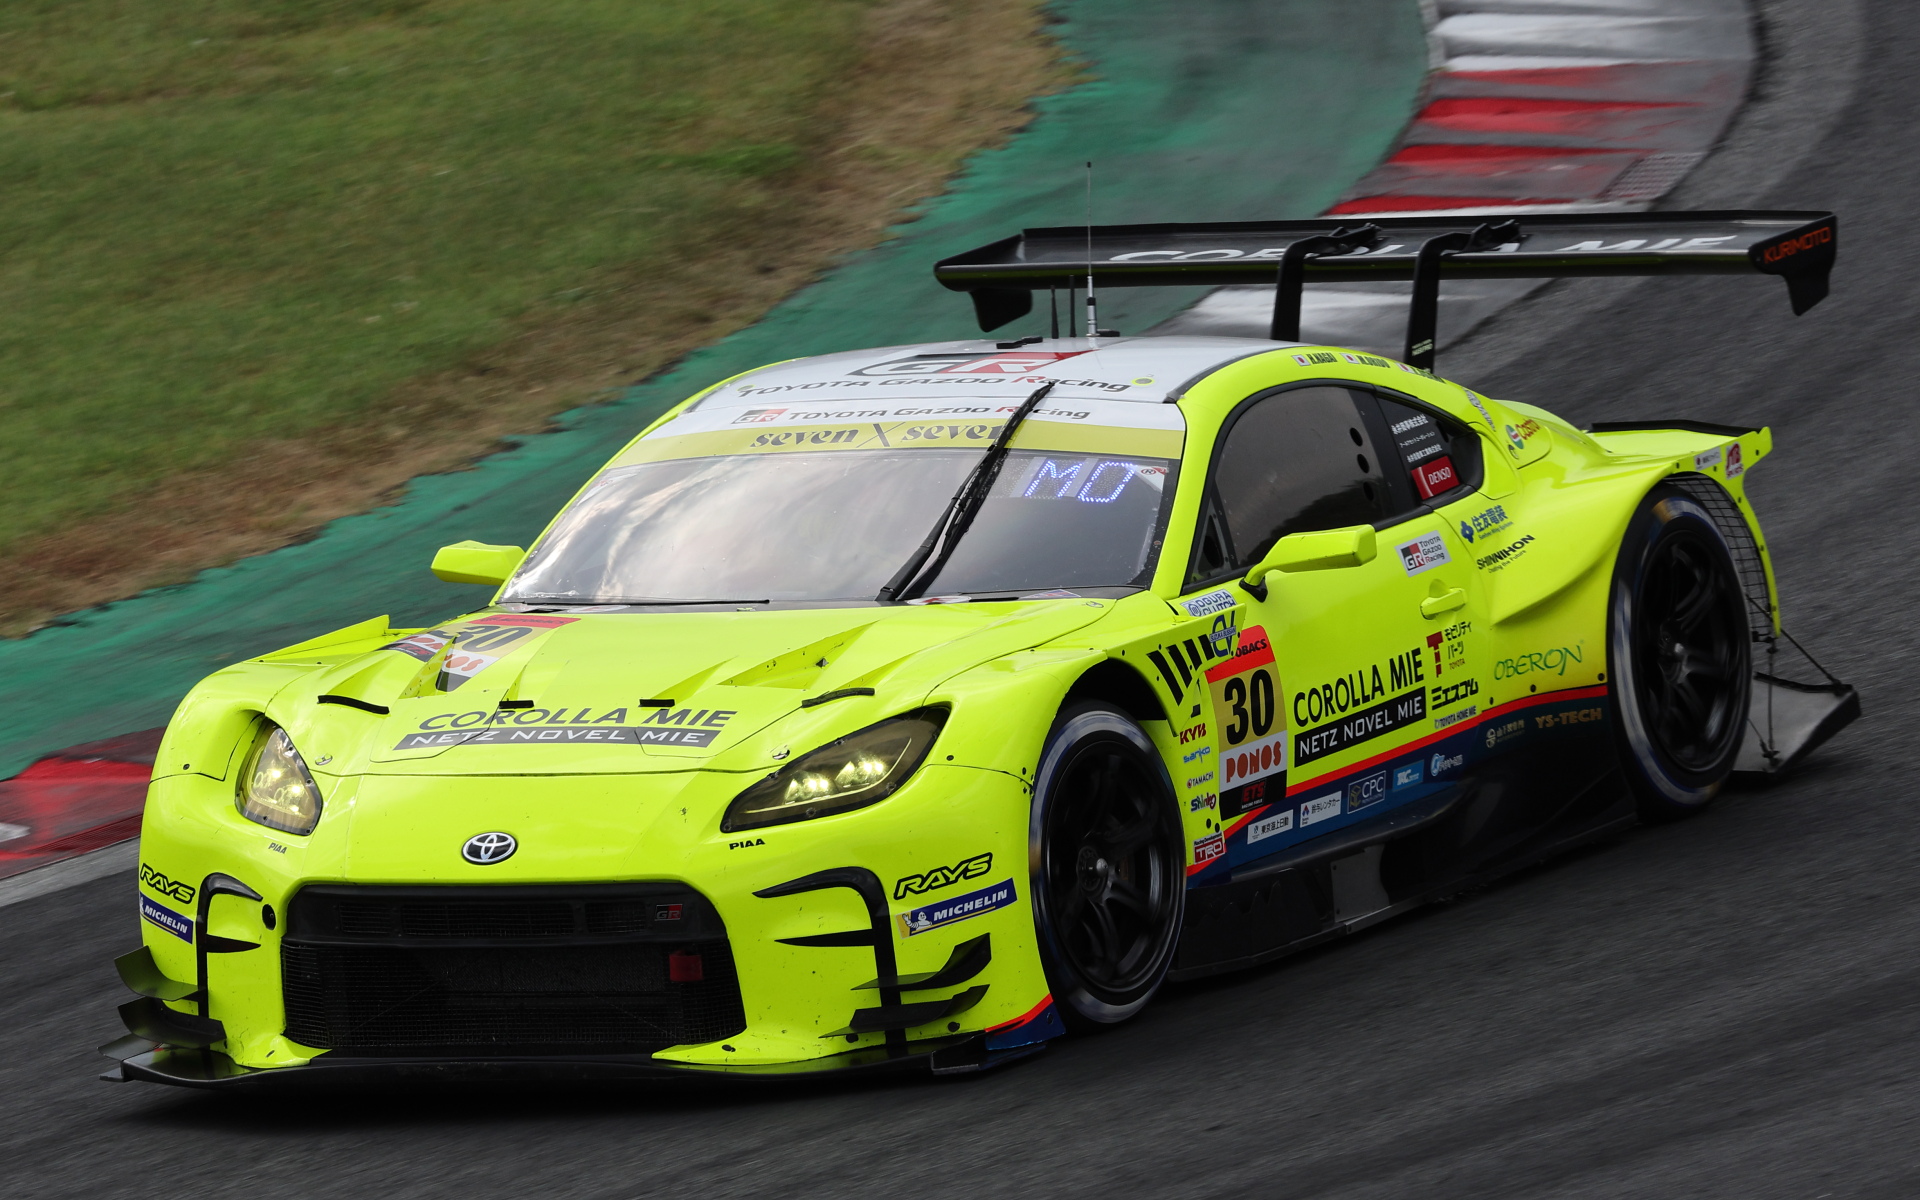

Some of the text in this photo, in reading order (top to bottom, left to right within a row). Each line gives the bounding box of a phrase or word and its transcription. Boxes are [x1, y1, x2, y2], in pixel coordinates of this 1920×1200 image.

[1763, 226, 1831, 264] KURIMOTO
[739, 375, 1131, 397] TOYOTA GAZOO Racing
[789, 409, 887, 420] TOYOTA
[893, 406, 991, 416] GAZOO
[994, 405, 1090, 420] Rcing
[750, 429, 859, 448] seven
[1428, 466, 1452, 486] DENSO
[1472, 504, 1508, 533] 住友電装
[1419, 536, 1441, 549] TOYOTA
[1422, 544, 1443, 556] GAZOO
[1404, 552, 1426, 570] GR
[1425, 552, 1445, 564] Racing
[1444, 621, 1472, 641] モビリティ
[1448, 658, 1466, 670] TOYOTA
[1494, 645, 1582, 681] OBERON
[1293, 647, 1424, 727] COROLLA MIE
[1223, 669, 1275, 745] 30
[1535, 707, 1603, 729] YS-TECH
[418, 707, 738, 731] COROLLA MIE
[1300, 696, 1422, 757] NETZ NOVEL MIE
[410, 728, 706, 746] NETZ NOVEL MIE
[1180, 722, 1207, 745] KYB
[1226, 740, 1282, 783] PONOS
[1192, 771, 1214, 786] TAMACHI
[1362, 776, 1384, 798] CPC
[1243, 781, 1265, 803] ETS
[268, 842, 288, 855] PIAA
[728, 838, 766, 850] PIAA
[1196, 840, 1223, 861] TRD
[140, 863, 196, 905] RAYS
[893, 852, 993, 900] RAYS
[655, 909, 682, 921] GR
[933, 888, 1008, 922] MICHELIN
[144, 905, 188, 934] MICHELIN
